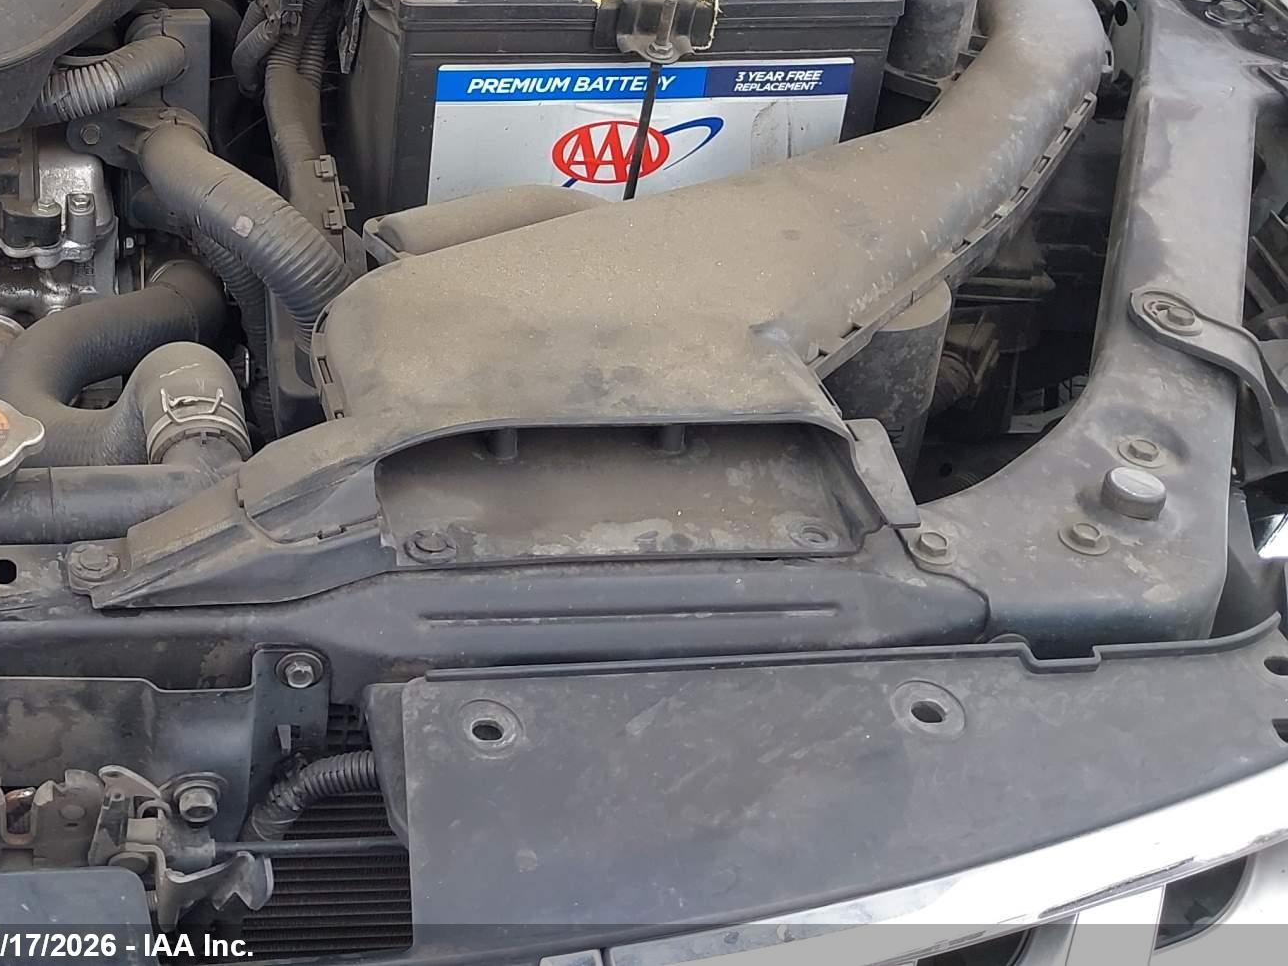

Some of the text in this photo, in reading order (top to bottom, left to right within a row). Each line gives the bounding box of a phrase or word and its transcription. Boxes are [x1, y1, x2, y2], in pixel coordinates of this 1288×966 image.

[735, 70, 824, 82] 3 YEAR FREE
[466, 77, 572, 94] PREMIUM
[555, 121, 667, 183] AAA
